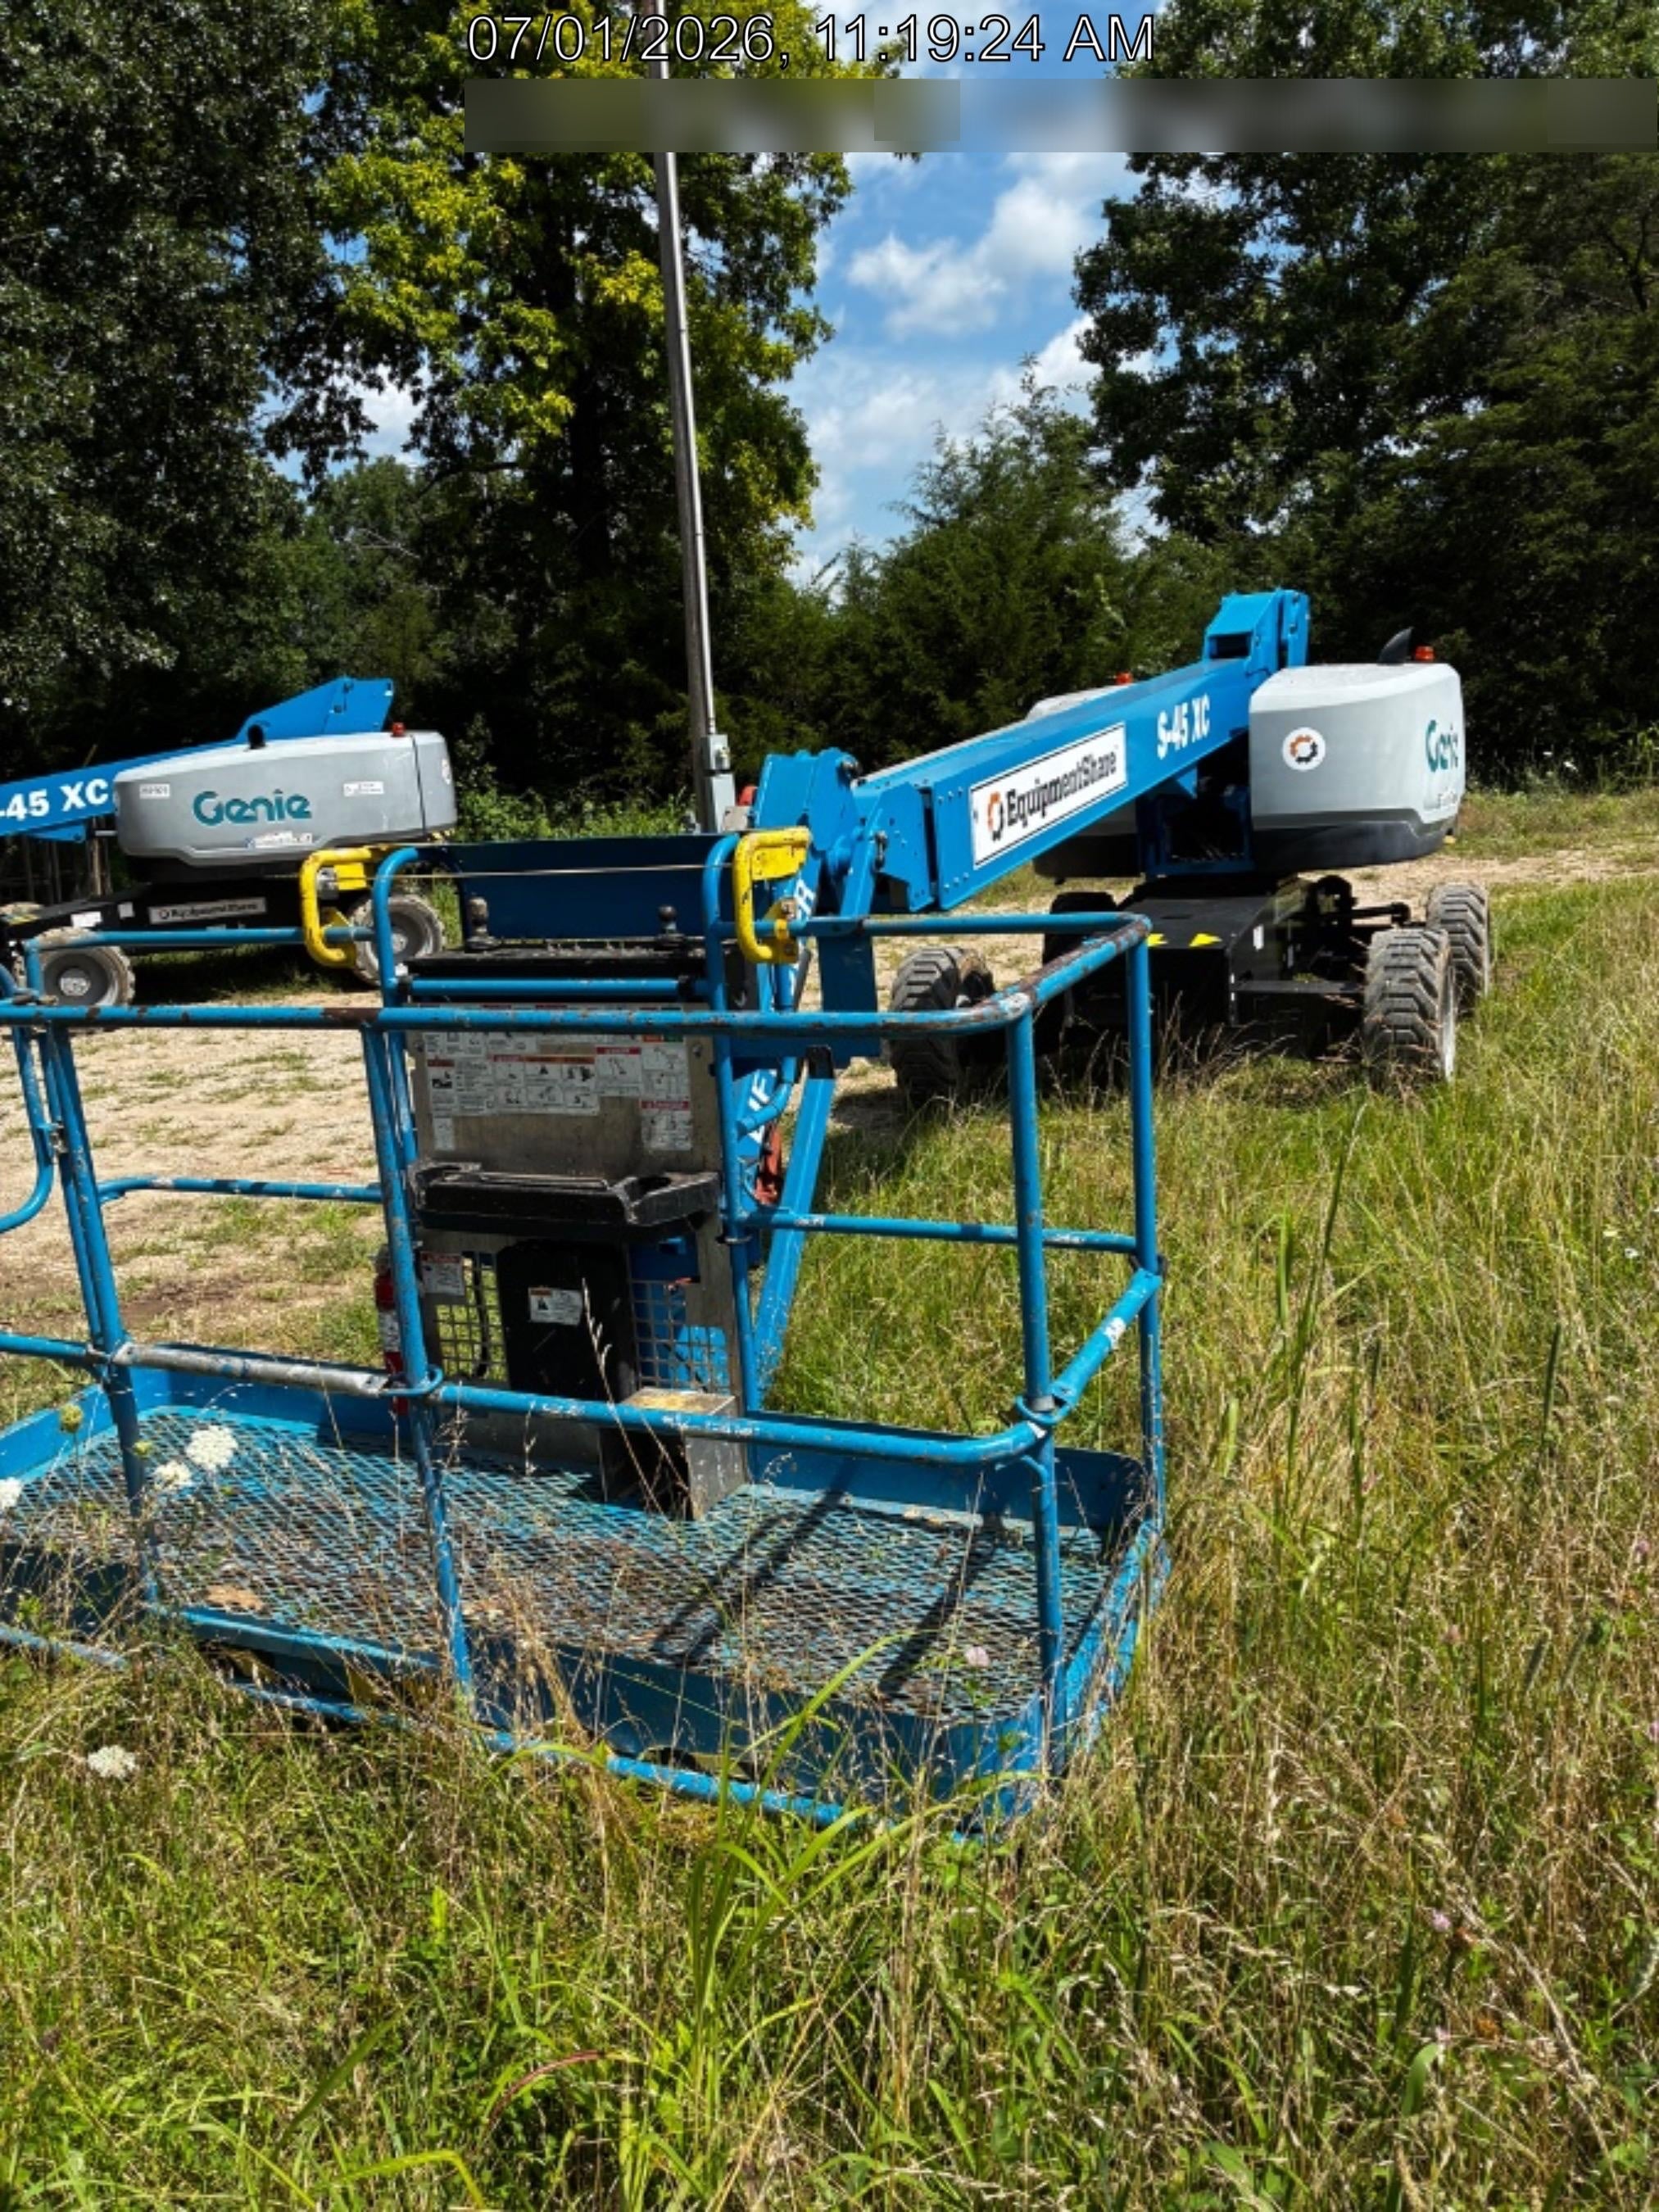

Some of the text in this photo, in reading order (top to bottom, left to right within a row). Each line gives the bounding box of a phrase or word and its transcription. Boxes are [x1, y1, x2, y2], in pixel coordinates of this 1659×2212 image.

[1157, 692, 1210, 760] S-45 XC
[59, 777, 109, 812] XC
[193, 788, 312, 827] Genie
[1005, 750, 1117, 828] EquipmentShare
